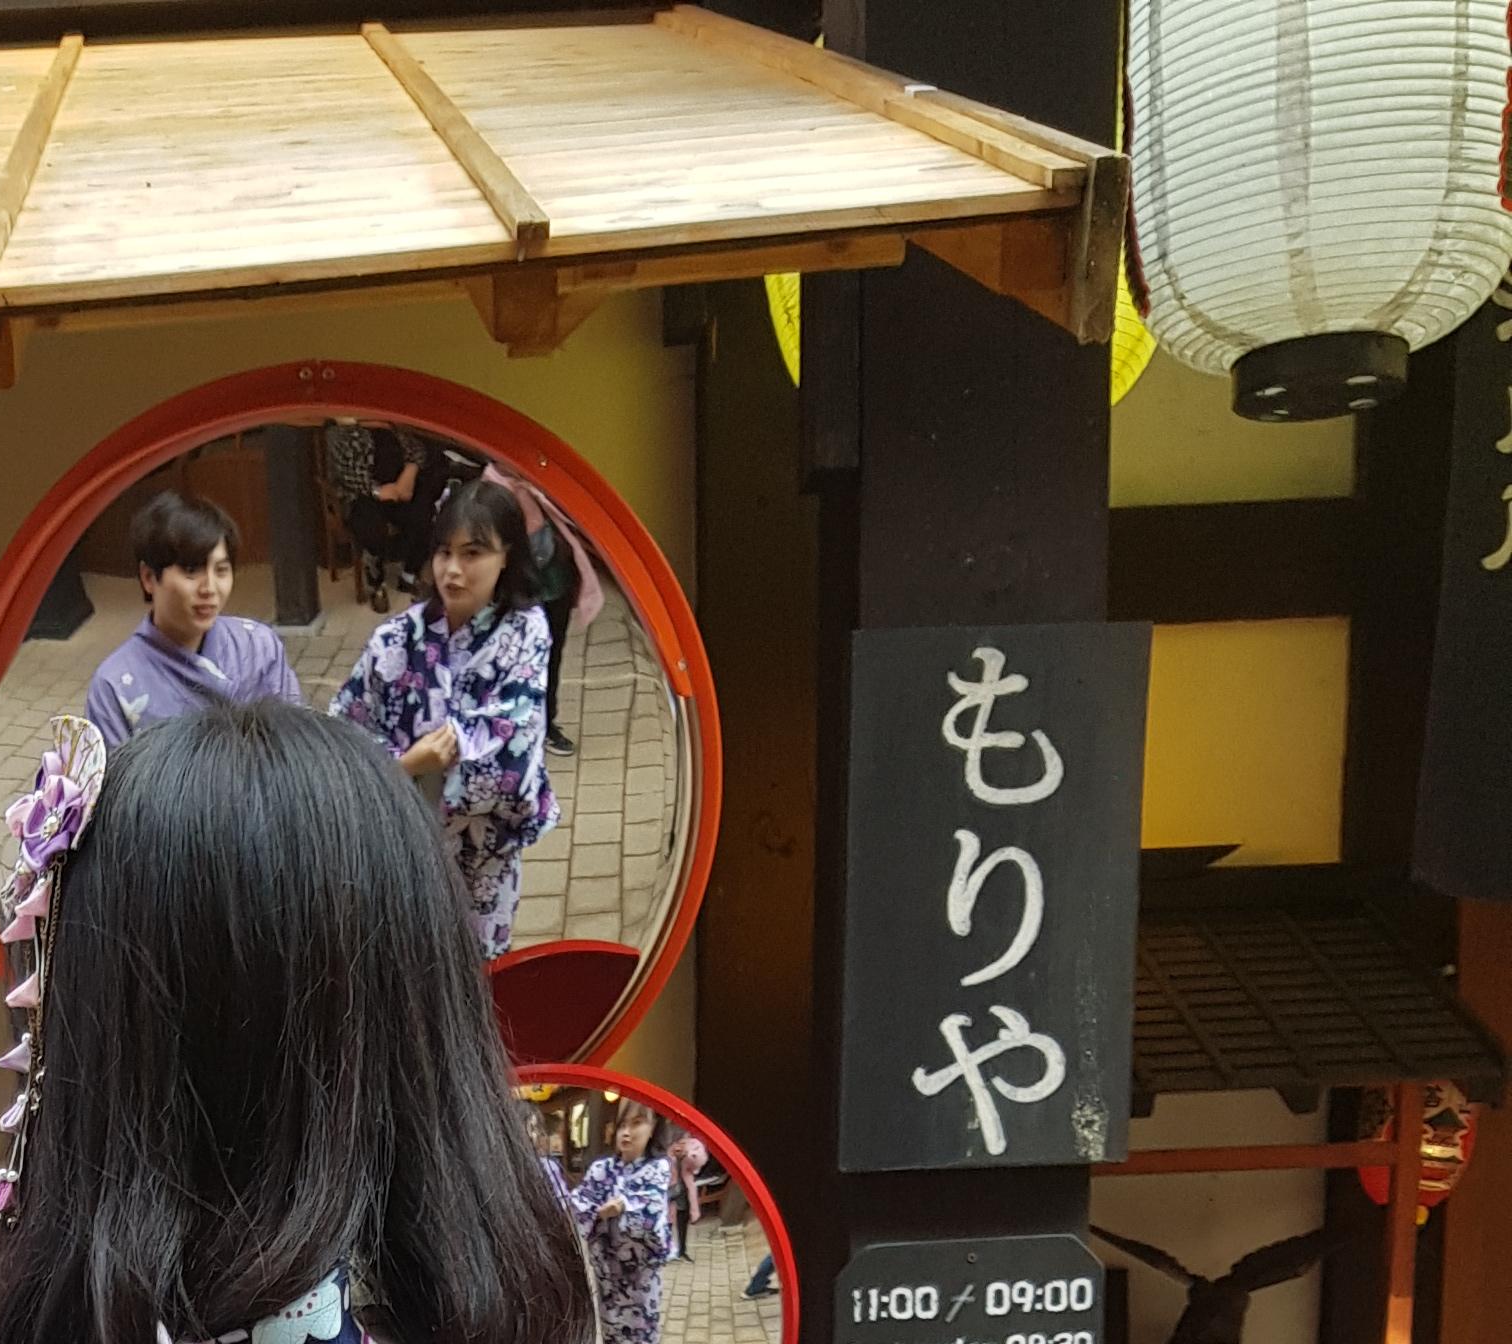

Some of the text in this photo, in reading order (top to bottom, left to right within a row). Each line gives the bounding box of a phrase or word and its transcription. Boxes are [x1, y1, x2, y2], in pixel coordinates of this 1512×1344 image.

[912, 646, 1066, 1156] もりや
[851, 1286, 939, 1323] 11:00
[985, 1277, 1093, 1317] 09:00
